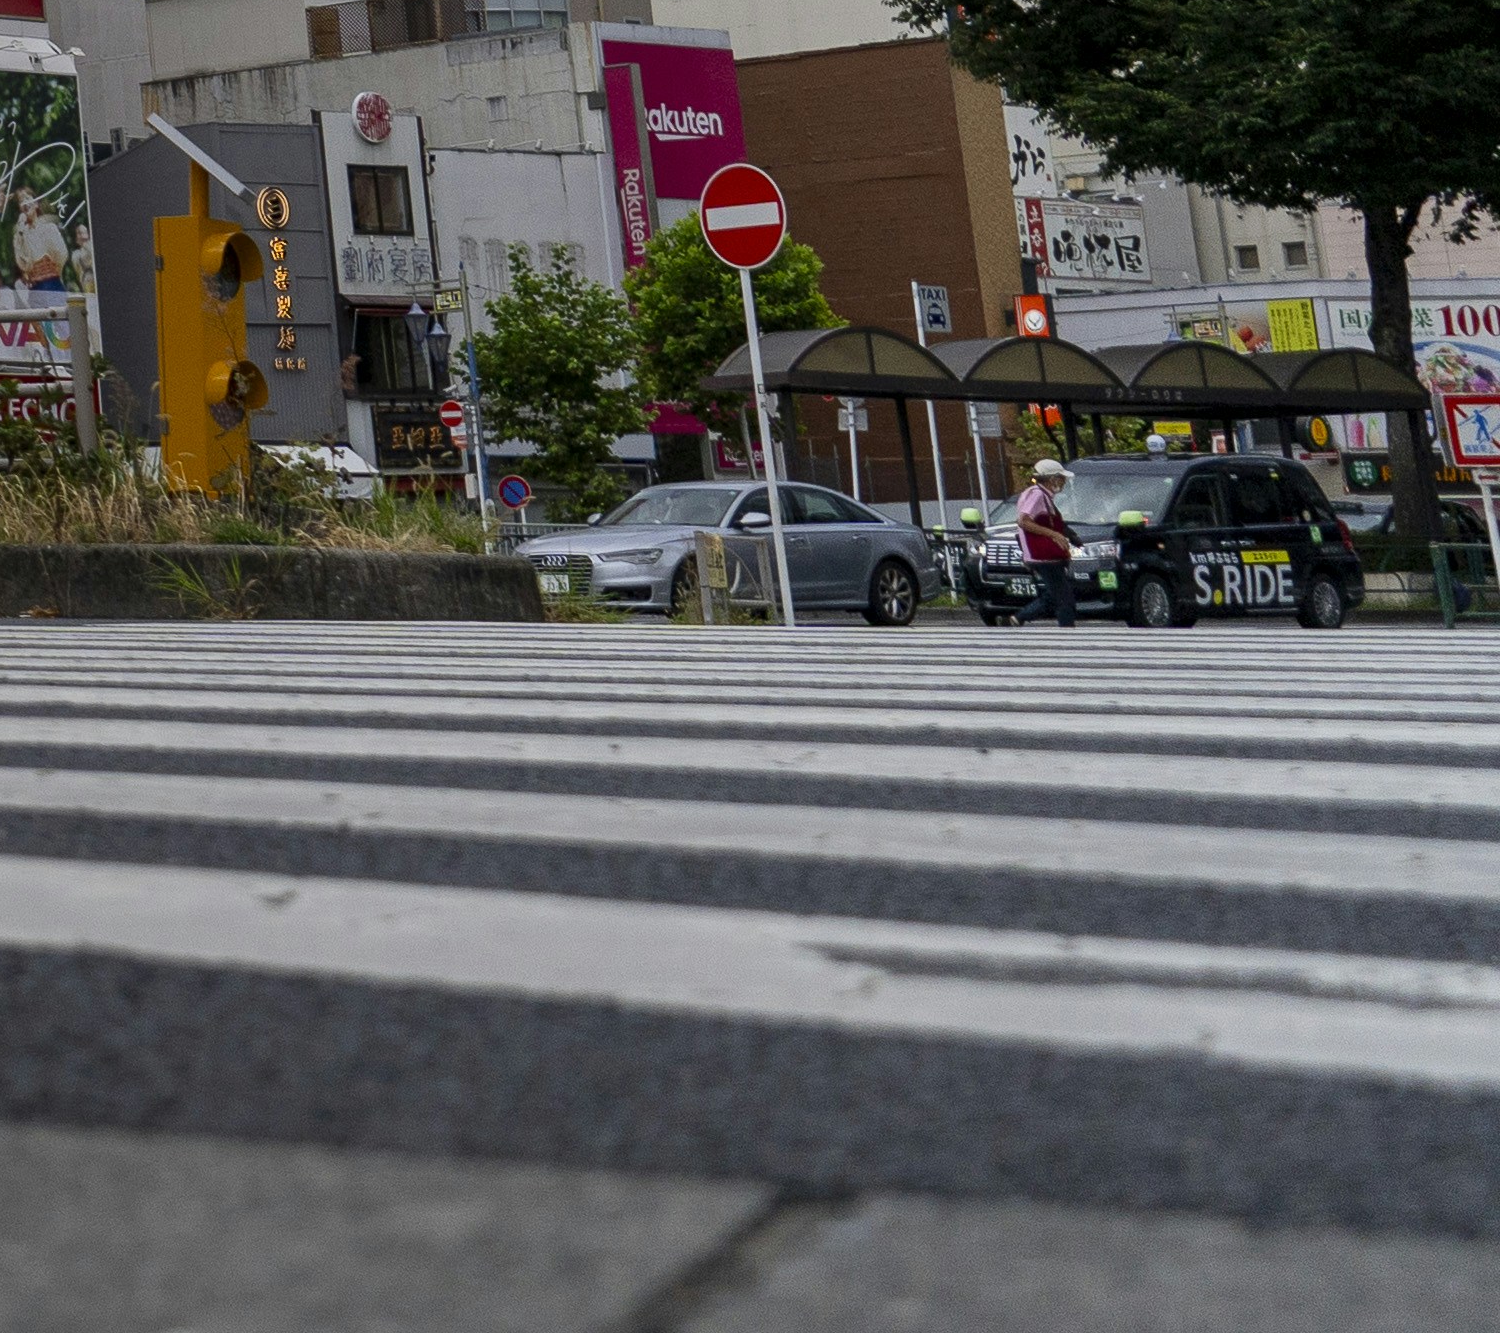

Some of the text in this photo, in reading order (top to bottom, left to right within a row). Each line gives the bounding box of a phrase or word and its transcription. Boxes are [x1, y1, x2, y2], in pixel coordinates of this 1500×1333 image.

[623, 167, 647, 257] Rakuten
[920, 287, 947, 302] TAXI
[1193, 564, 1295, 605] S.RIDE
